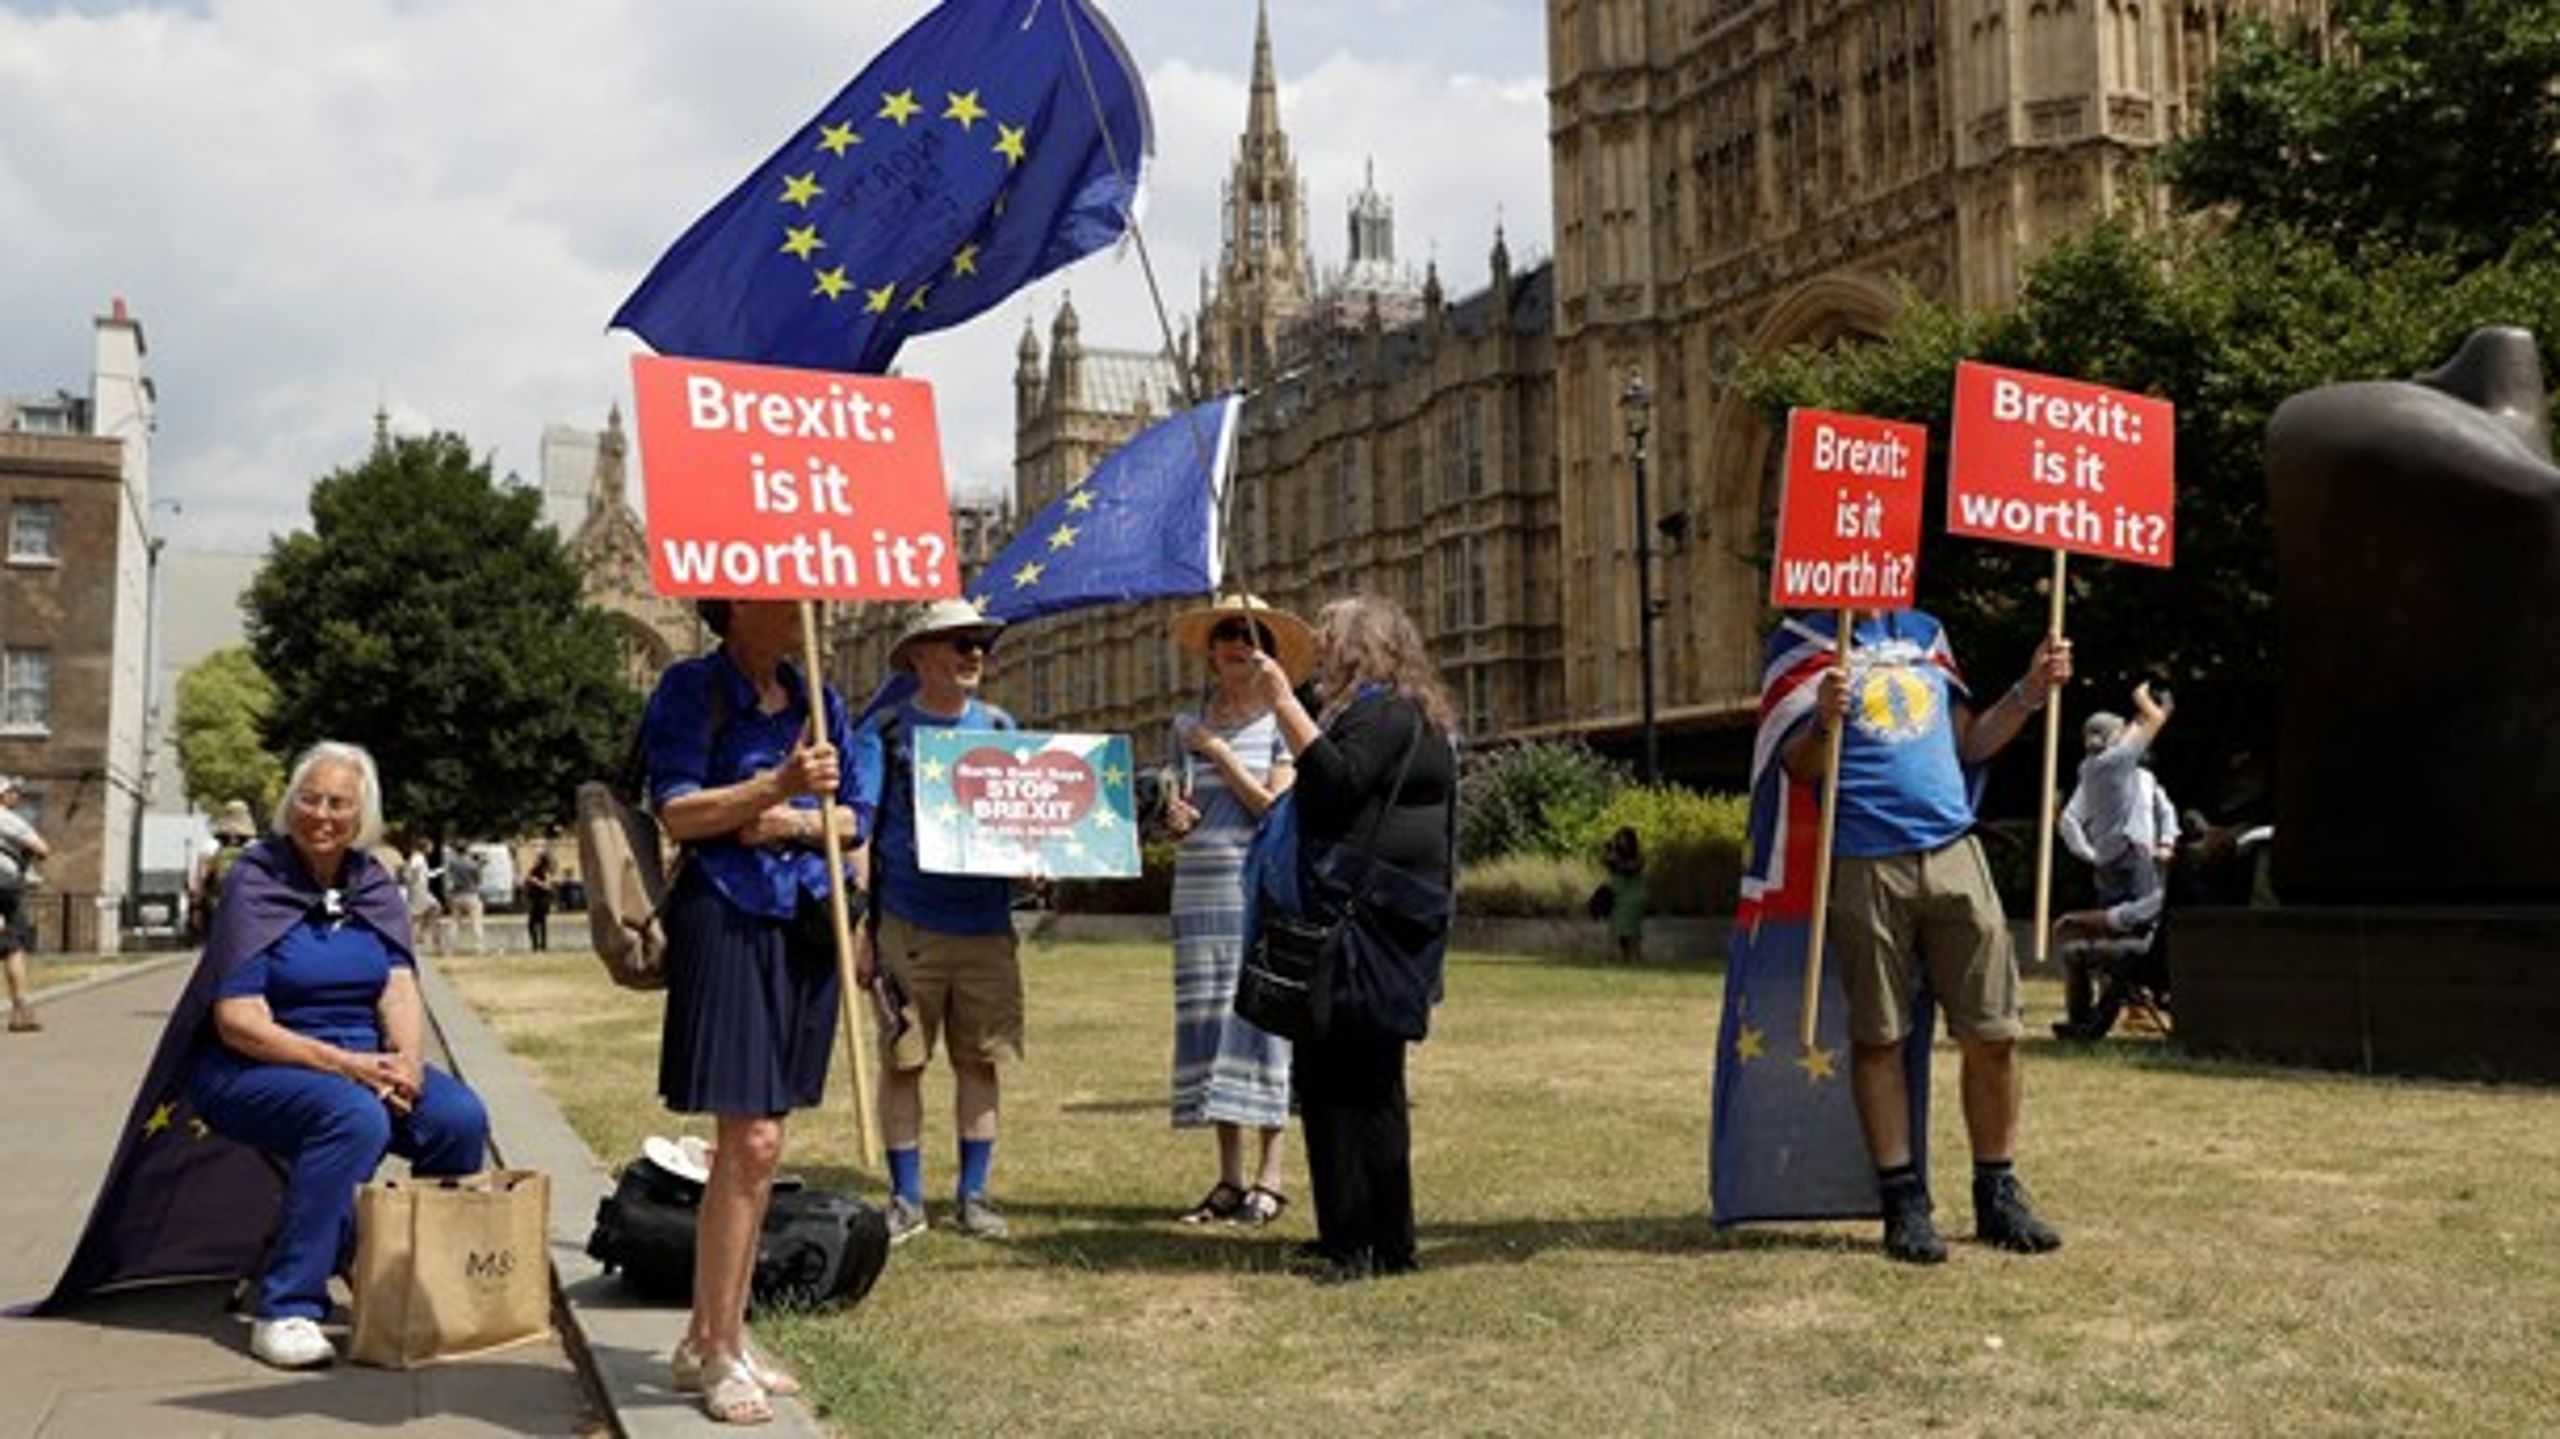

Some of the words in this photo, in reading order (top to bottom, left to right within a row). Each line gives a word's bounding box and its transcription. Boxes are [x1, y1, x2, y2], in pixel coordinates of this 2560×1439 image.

[687, 374, 895, 443] Brexit:
[1994, 379, 2142, 443] Brexit:
[1814, 425, 1910, 480] Brexit:
[2034, 439, 2066, 484] is
[2075, 445, 2105, 492] it
[751, 453, 799, 514] is
[807, 457, 853, 516] it
[1837, 488, 1861, 537] is
[1863, 491, 1883, 539] it
[1960, 494, 2102, 545] worth
[2113, 506, 2166, 555] it?
[662, 529, 858, 587] worth
[873, 530, 945, 588] it?
[1783, 551, 1877, 597] worth
[1880, 552, 1915, 597] it?
[973, 800, 1074, 820] BREXIT
[985, 780, 1059, 799] STOP
